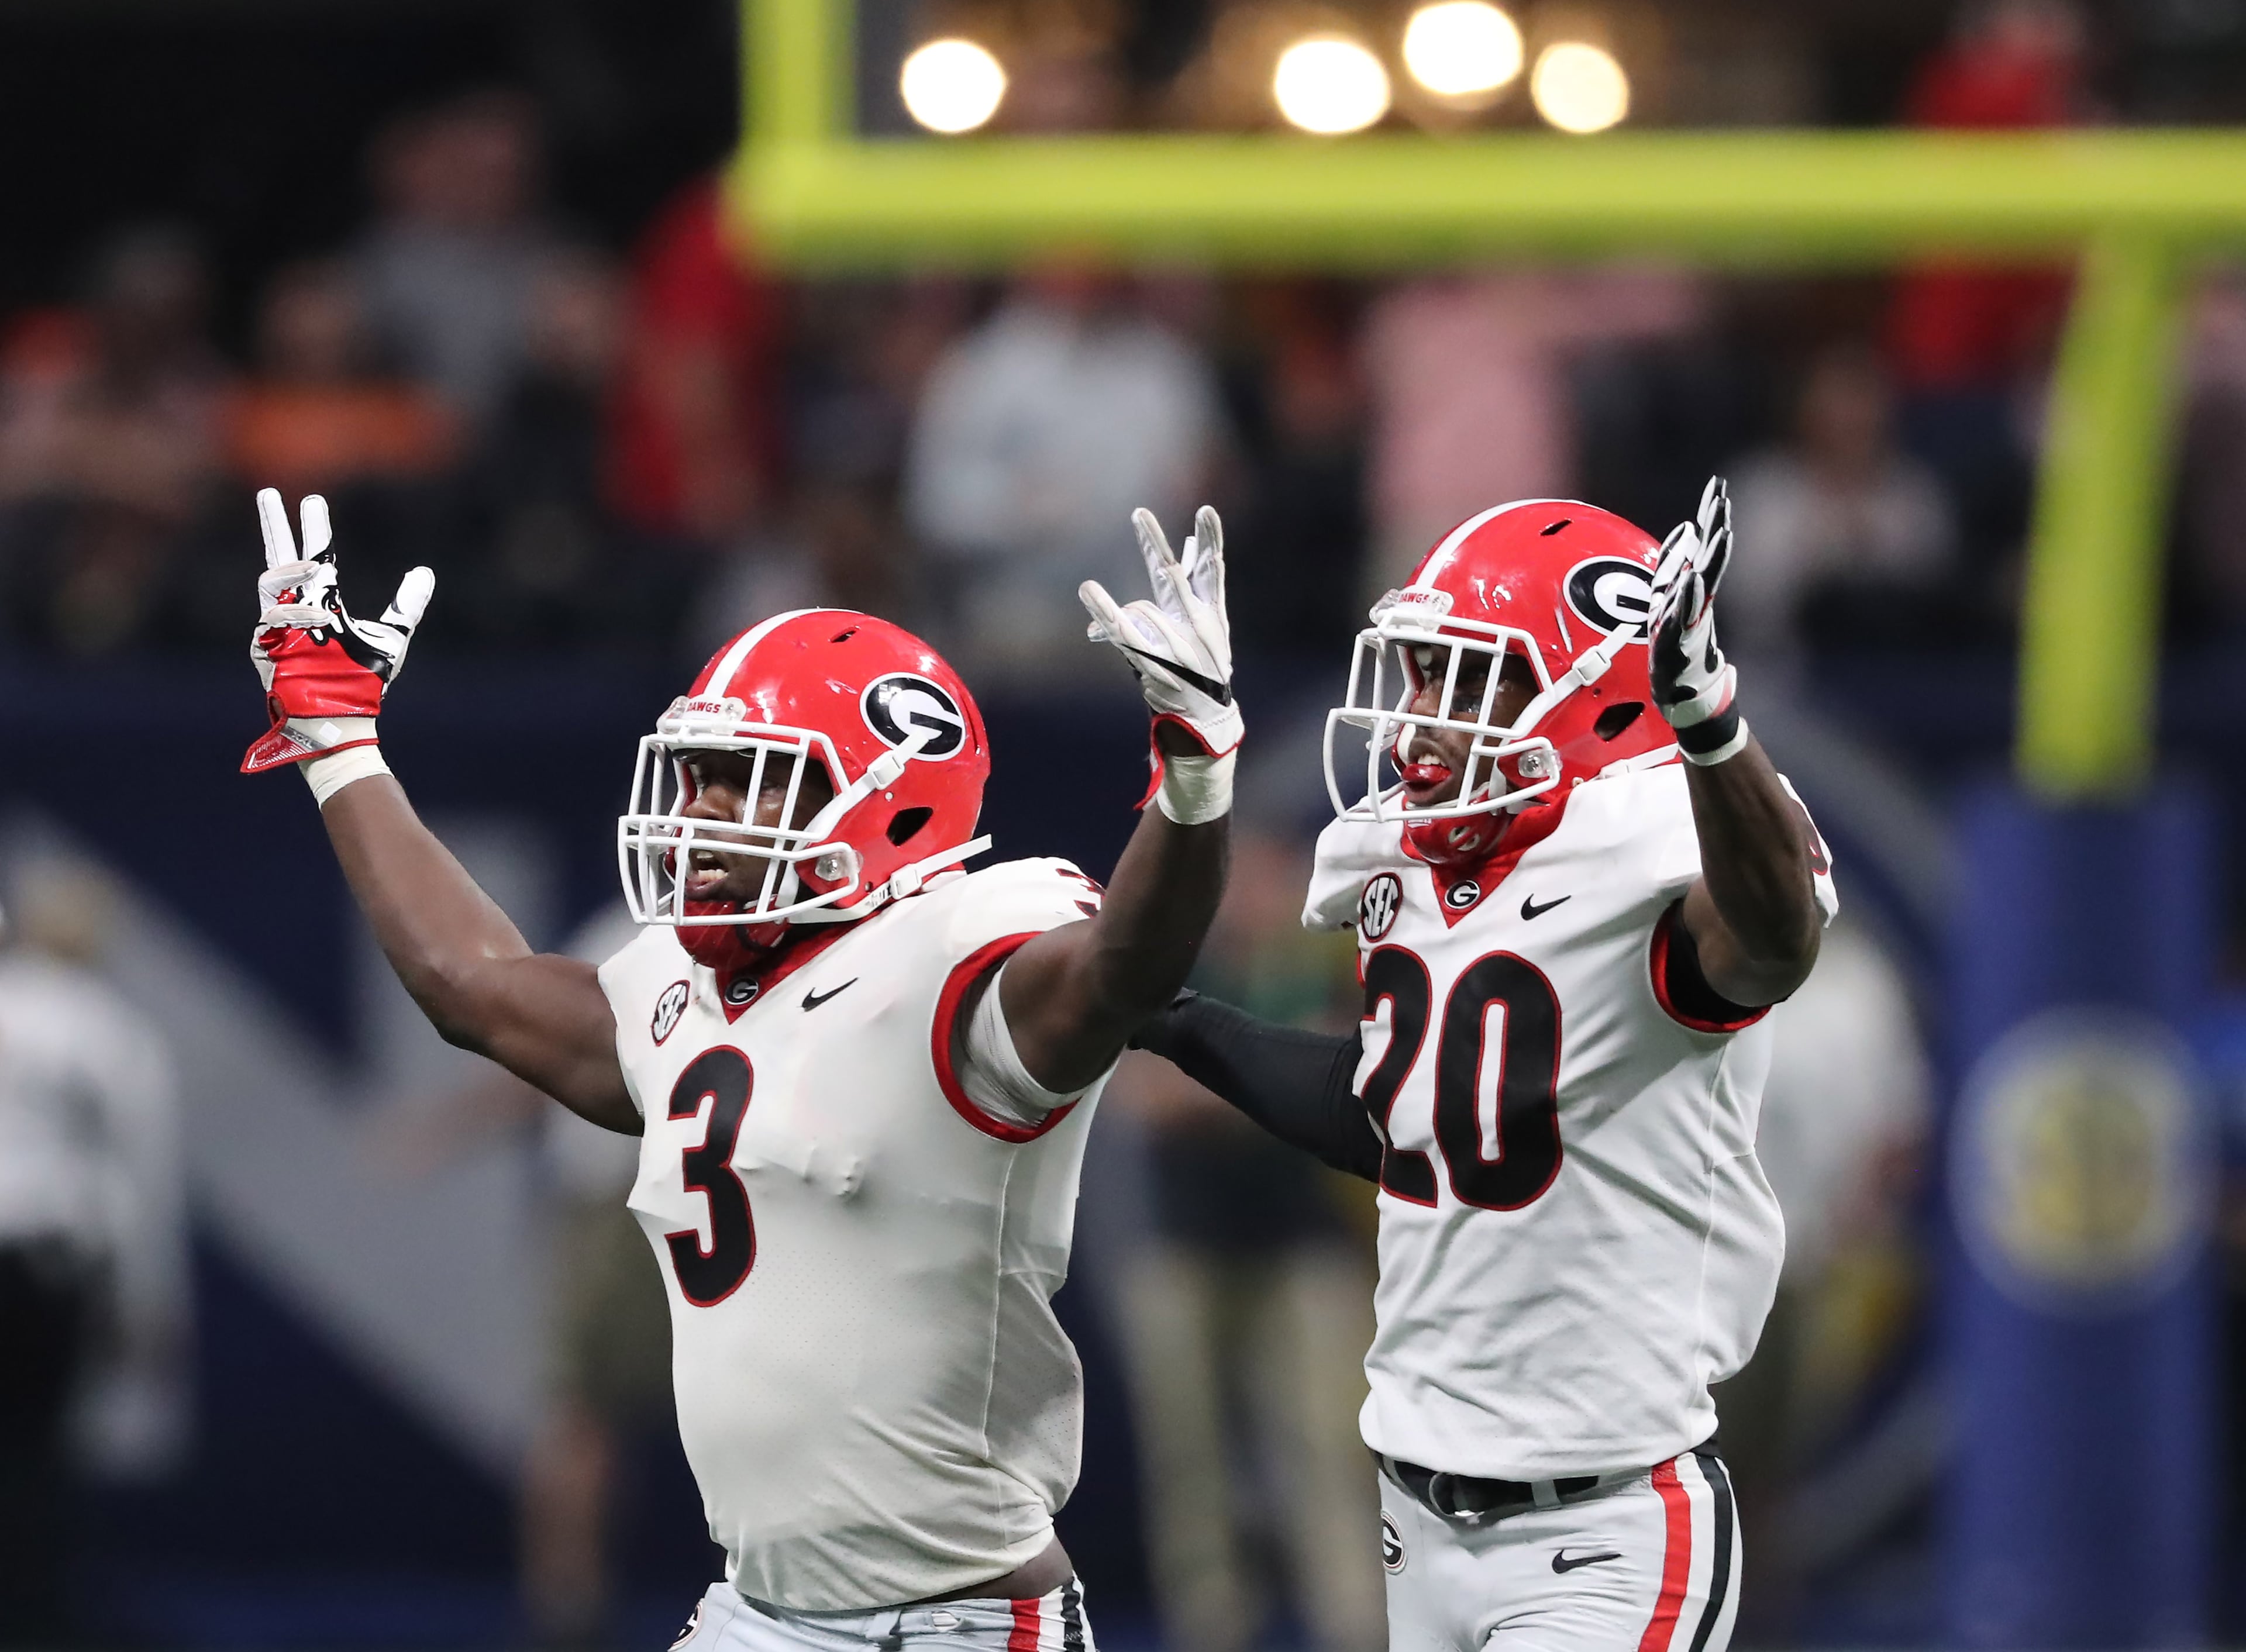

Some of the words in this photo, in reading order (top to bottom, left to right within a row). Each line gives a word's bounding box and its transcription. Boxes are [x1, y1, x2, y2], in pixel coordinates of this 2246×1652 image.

[1568, 560, 1655, 639] G
[865, 677, 964, 756] G
[1362, 875, 1400, 938] SEC
[1445, 880, 1479, 908] G
[725, 977, 759, 1005] G
[1359, 944, 1562, 1211] 20
[664, 1044, 756, 1308] 3
